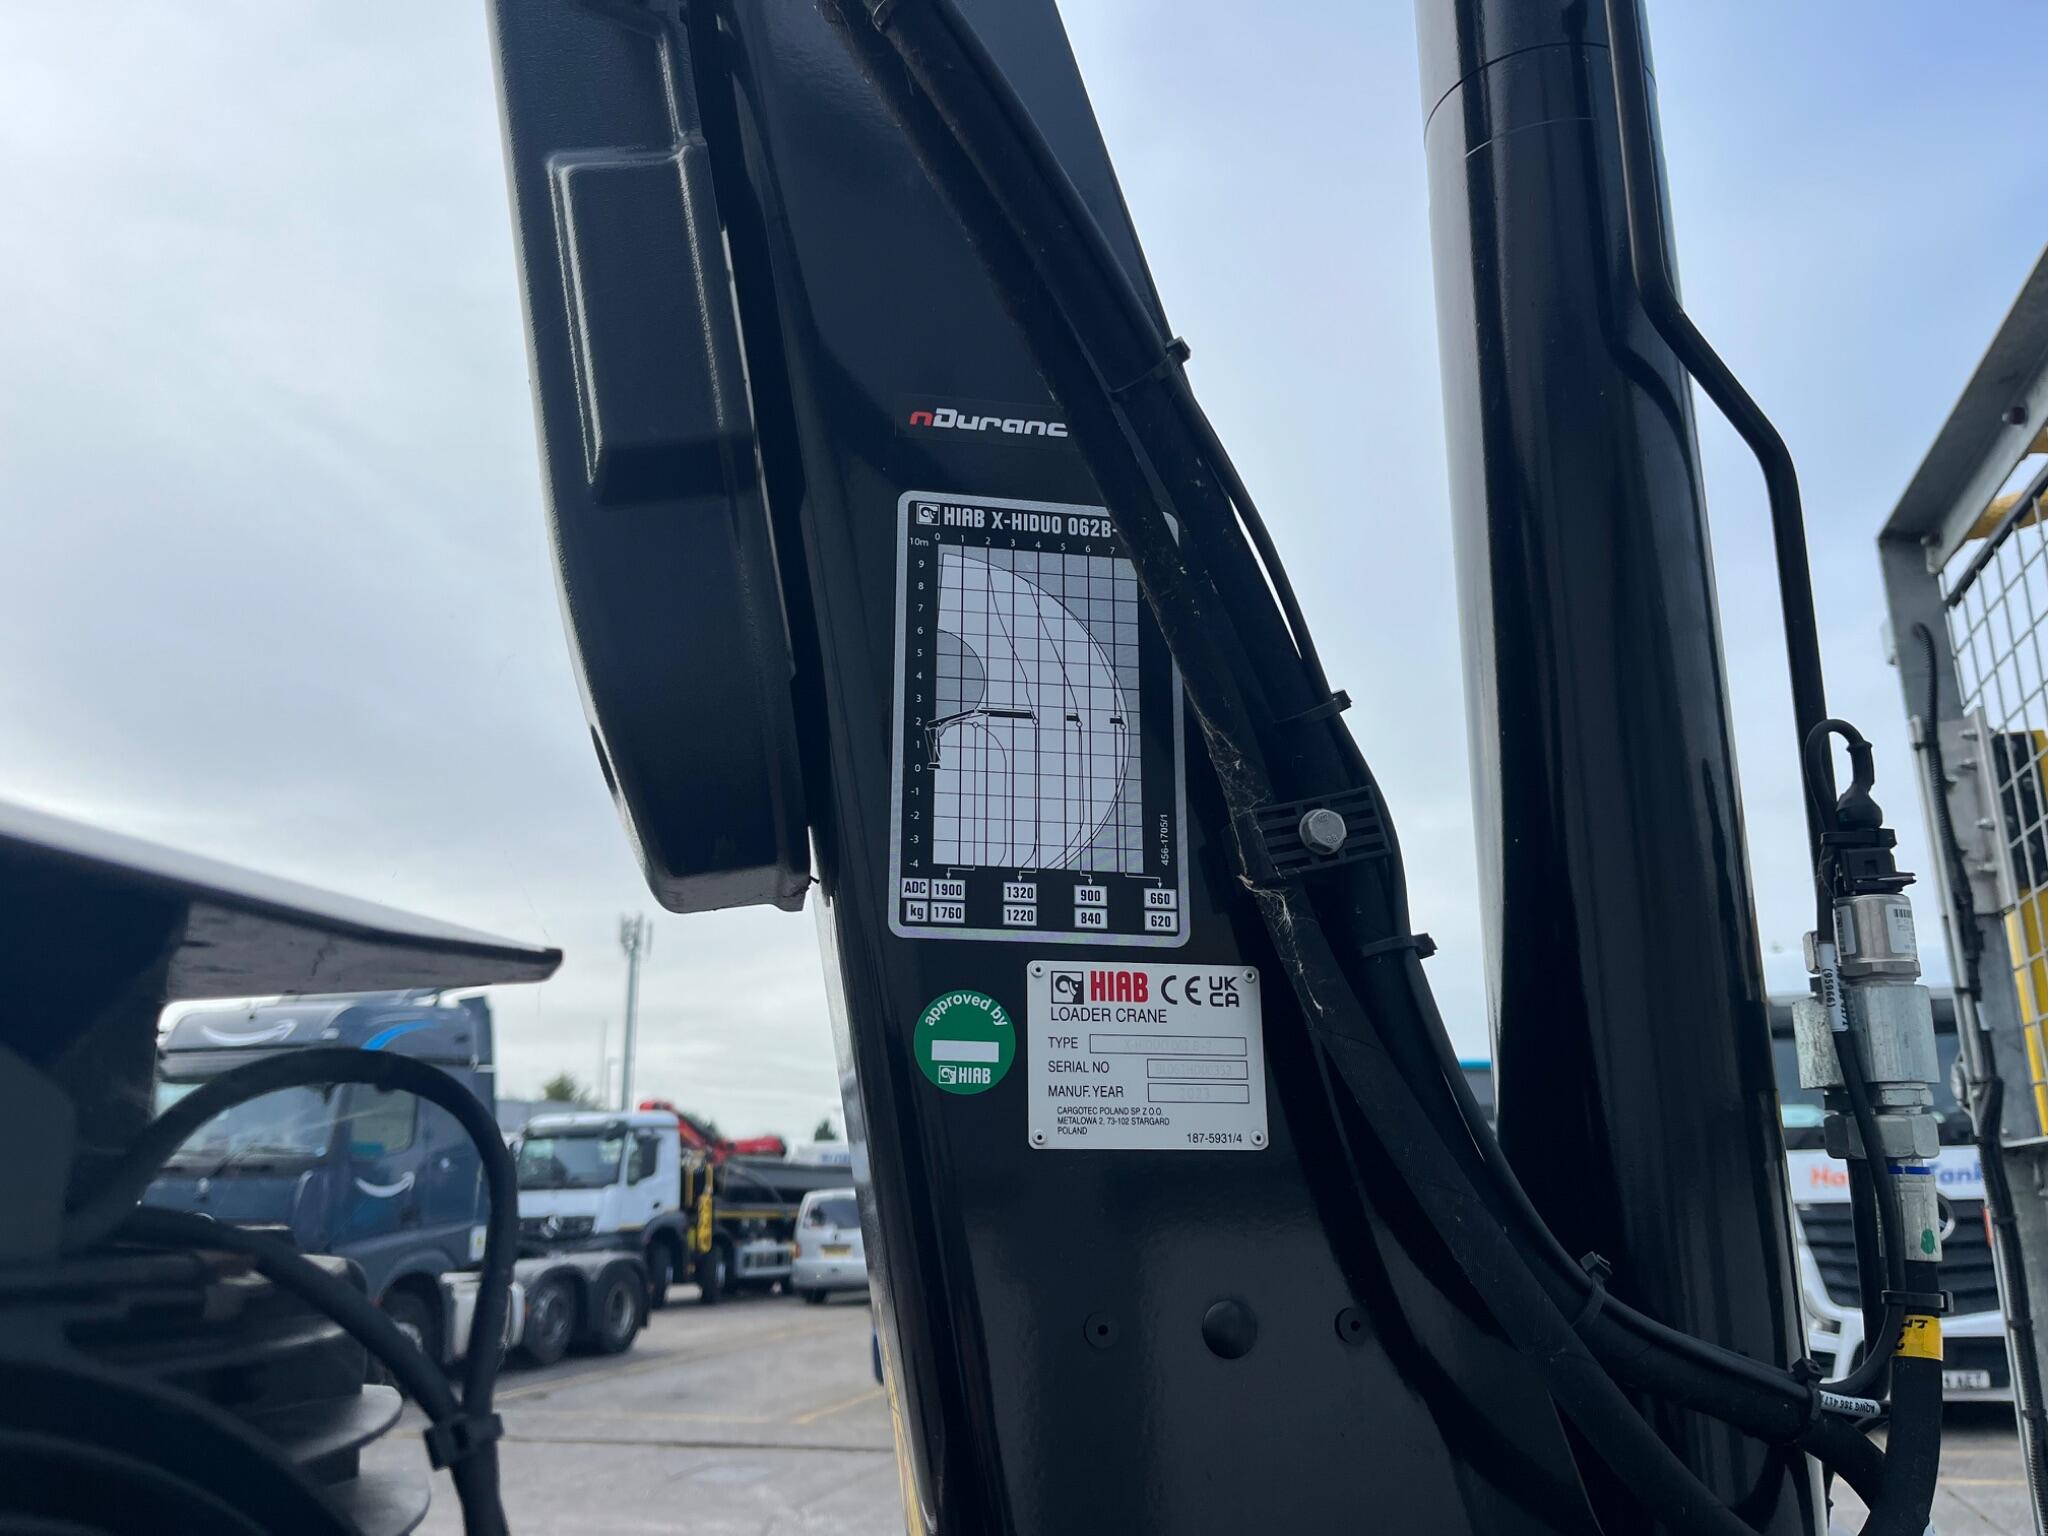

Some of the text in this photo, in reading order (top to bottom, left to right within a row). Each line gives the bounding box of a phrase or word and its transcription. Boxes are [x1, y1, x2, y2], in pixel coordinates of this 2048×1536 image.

[910, 408, 1068, 437] nDuranc
[943, 506, 1118, 538] HIAB X-HIDUO 062B-
[909, 537, 929, 547] 10m
[934, 532, 1116, 554] 0 1 2 3 4 5 6 7
[918, 559, 925, 568] 9
[918, 581, 924, 590] 8
[918, 603, 924, 612] 7
[917, 626, 924, 635] 6
[917, 648, 923, 657] 5
[916, 671, 922, 680] 4
[916, 694, 922, 703] 3
[915, 717, 922, 726] 2
[916, 740, 920, 749] 1
[914, 763, 921, 772] 0
[911, 787, 919, 796] -1
[910, 810, 920, 820] -2
[909, 834, 919, 844] -3
[1160, 813, 1169, 867] 456-1705/1
[910, 859, 919, 868] -4
[904, 882, 1170, 905] ADC 1900 1320 900 660
[910, 906, 1171, 928] kg 1760 1220 840 620
[1090, 971, 1202, 1005] HIAB CE
[1209, 976, 1240, 991] UK
[1209, 993, 1240, 1007] CA
[925, 994, 1008, 1026] approved by
[1051, 1007, 1167, 1023] LOADER CRANE
[1048, 1037, 1078, 1049] TYPE
[1048, 1061, 1109, 1073] SERIAL NO
[959, 1067, 991, 1084] HIAB
[1048, 1085, 1091, 1097] MANUF.
[1092, 1086, 1124, 1098] YEAR
[1057, 1106, 1098, 1115] CARGOTEC
[1100, 1107, 1129, 1115] POLAND
[1142, 1107, 1148, 1115] Z
[1057, 1117, 1097, 1125] METALOWA
[1107, 1117, 1129, 1125] 73-102
[1131, 1117, 1170, 1125] STARGARD
[1057, 1127, 1088, 1135] POLAND
[1187, 1133, 1242, 1144] 187-5931/4
